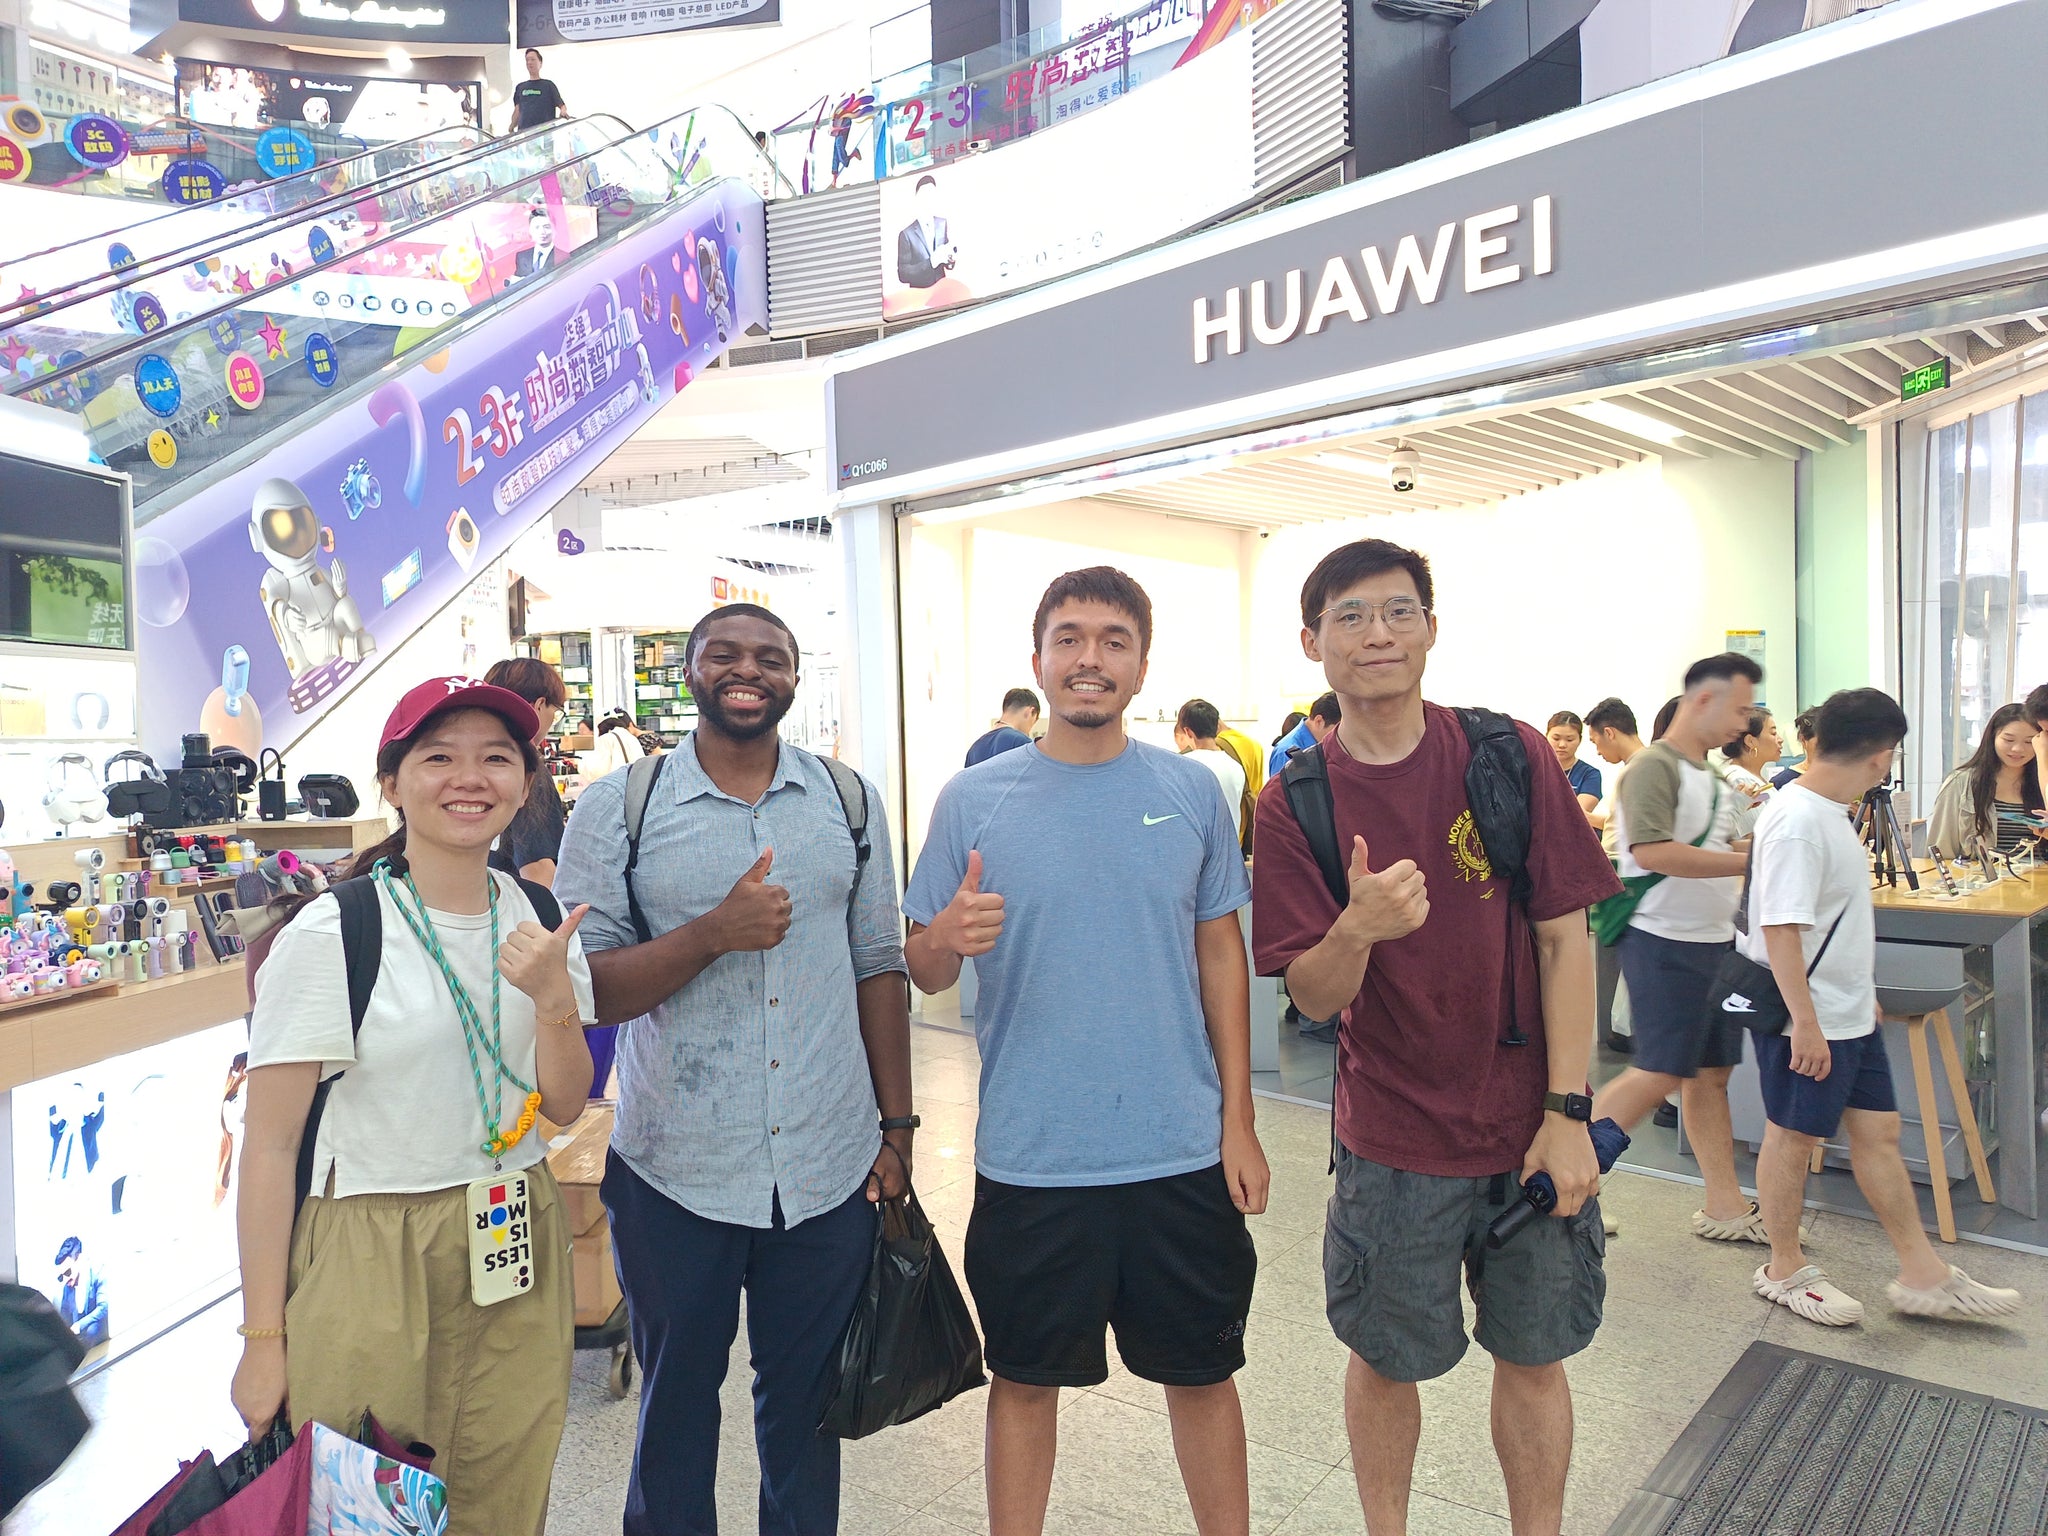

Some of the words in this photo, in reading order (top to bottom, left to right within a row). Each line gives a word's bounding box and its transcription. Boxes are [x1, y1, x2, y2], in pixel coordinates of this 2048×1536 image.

[558, 17, 591, 29] 数码产品
[594, 14, 627, 25] 办公耗材
[631, 11, 647, 21] 音响
[650, 8, 675, 18] IT电脑
[678, 4, 712, 16] 电子总部
[715, 0, 749, 12] LED产品
[903, 86, 990, 142] 2-3F
[86, 129, 105, 141] 3C
[1193, 194, 1554, 365] HUAWEI
[524, 313, 634, 424] 时尚数智中心
[443, 392, 519, 486] 2-3F
[851, 457, 888, 478] Q1C066
[1448, 815, 1466, 845] MOVE
[510, 1221, 528, 1242] IS
[484, 1243, 529, 1272] LESS
